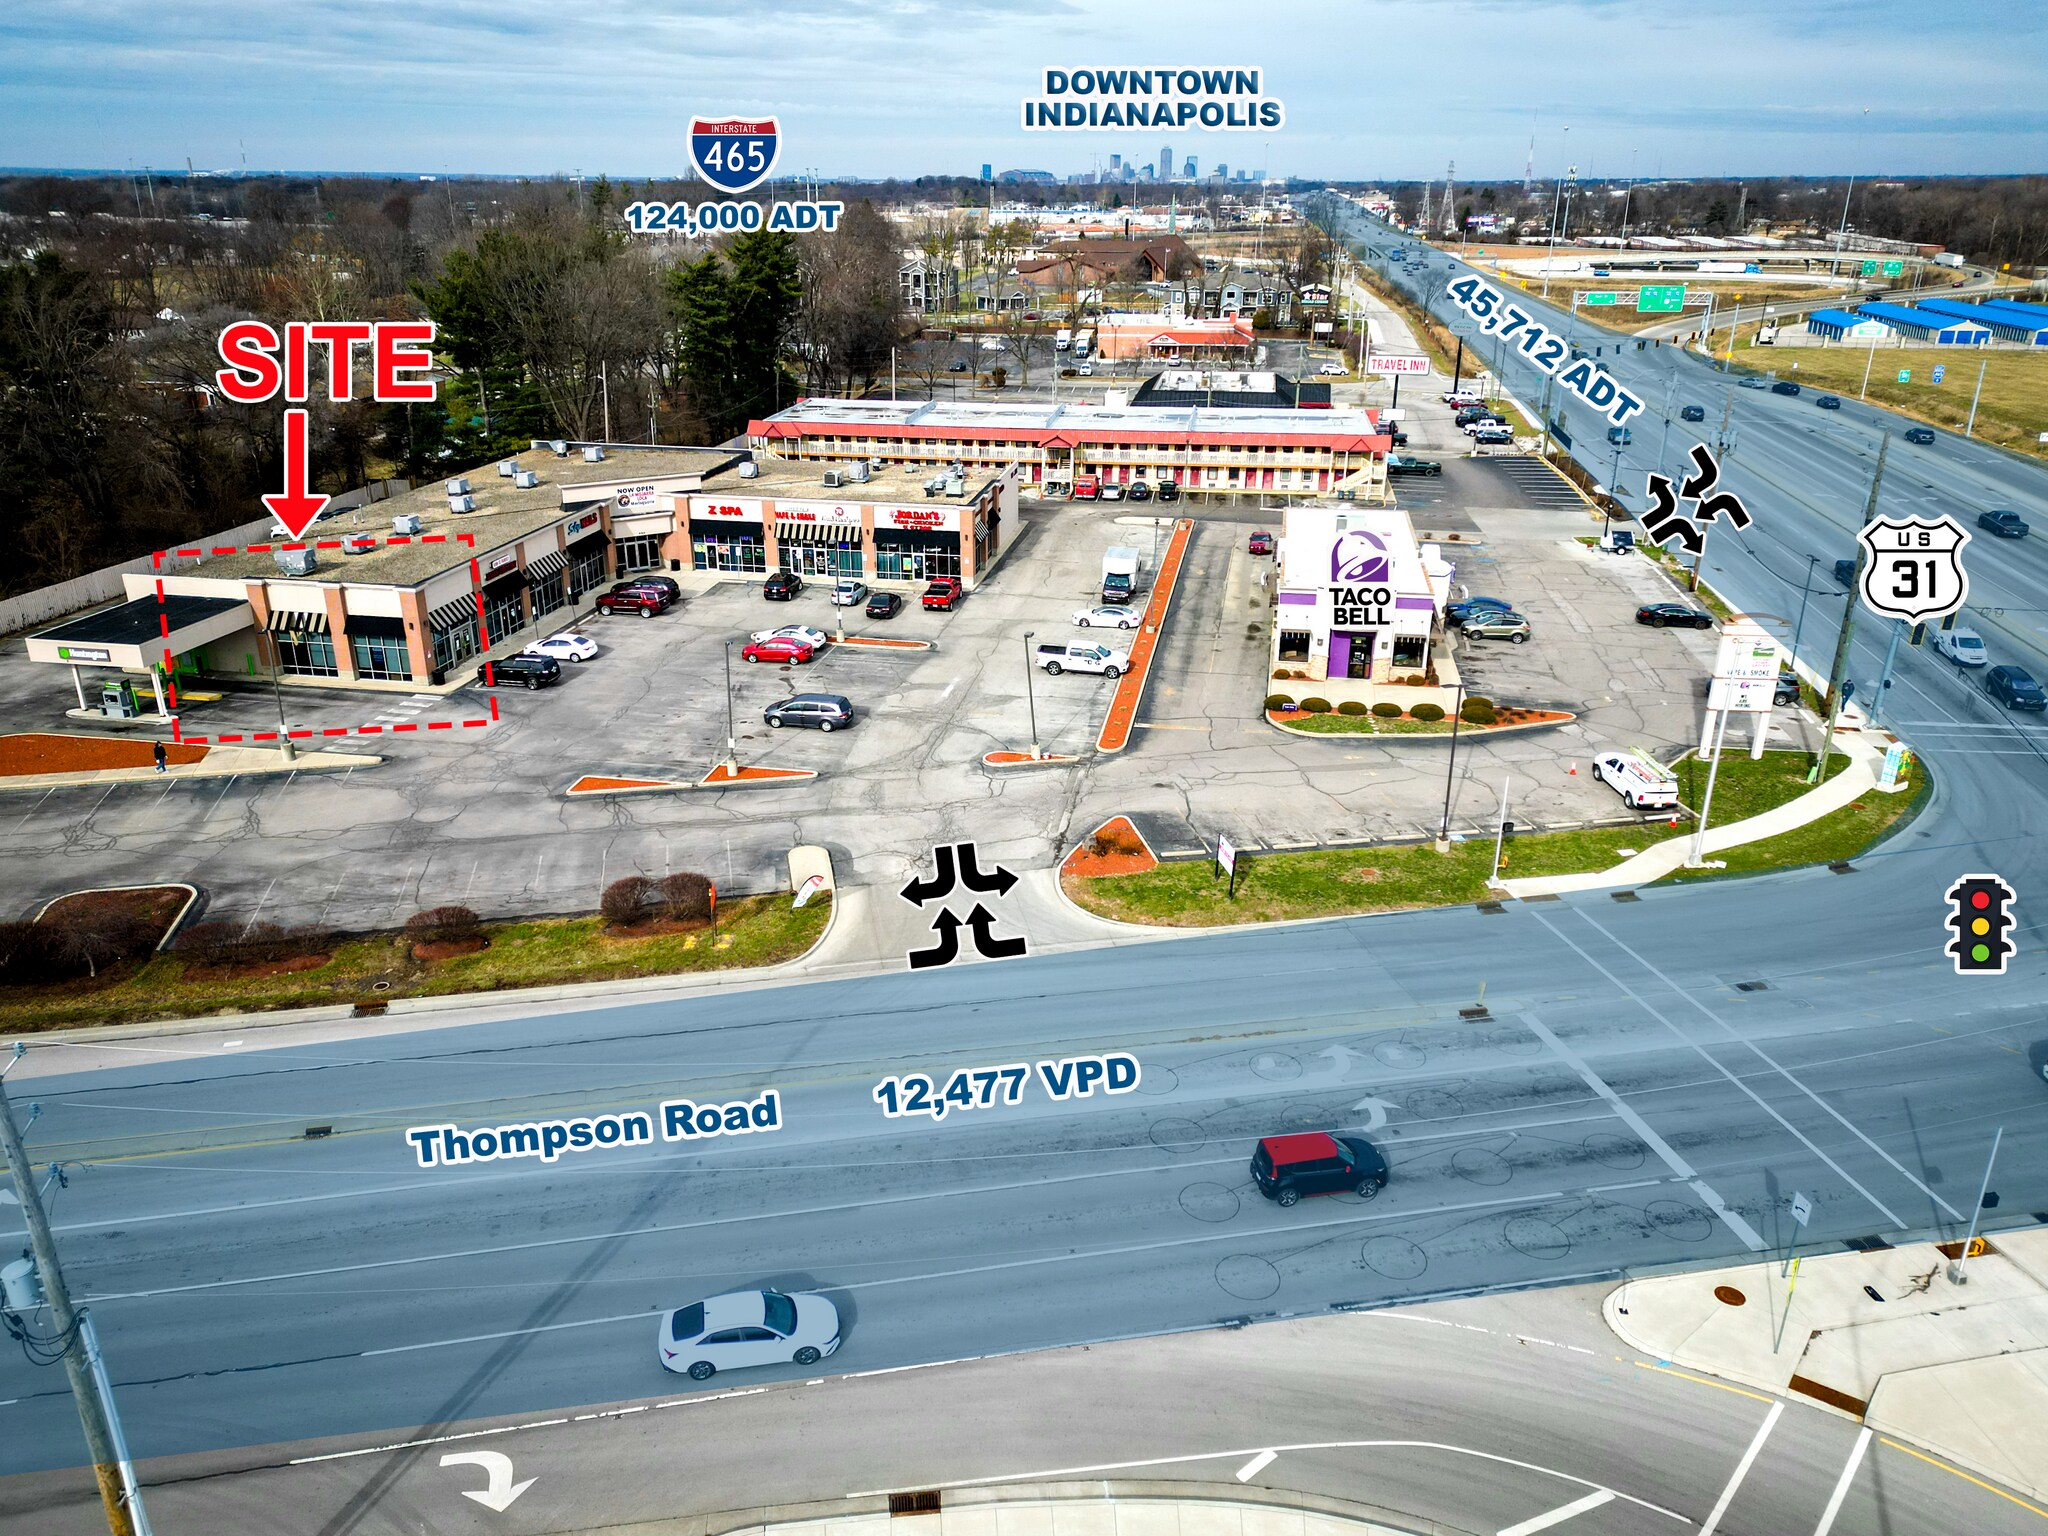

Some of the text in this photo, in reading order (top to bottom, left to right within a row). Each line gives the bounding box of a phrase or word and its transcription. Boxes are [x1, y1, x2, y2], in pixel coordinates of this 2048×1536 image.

[1372, 358, 1426, 371] TRAVEL INN
[708, 505, 743, 516] Z SPA
[895, 509, 940, 521] JORDAN'S
[1750, 669, 1770, 677] SMOKE
